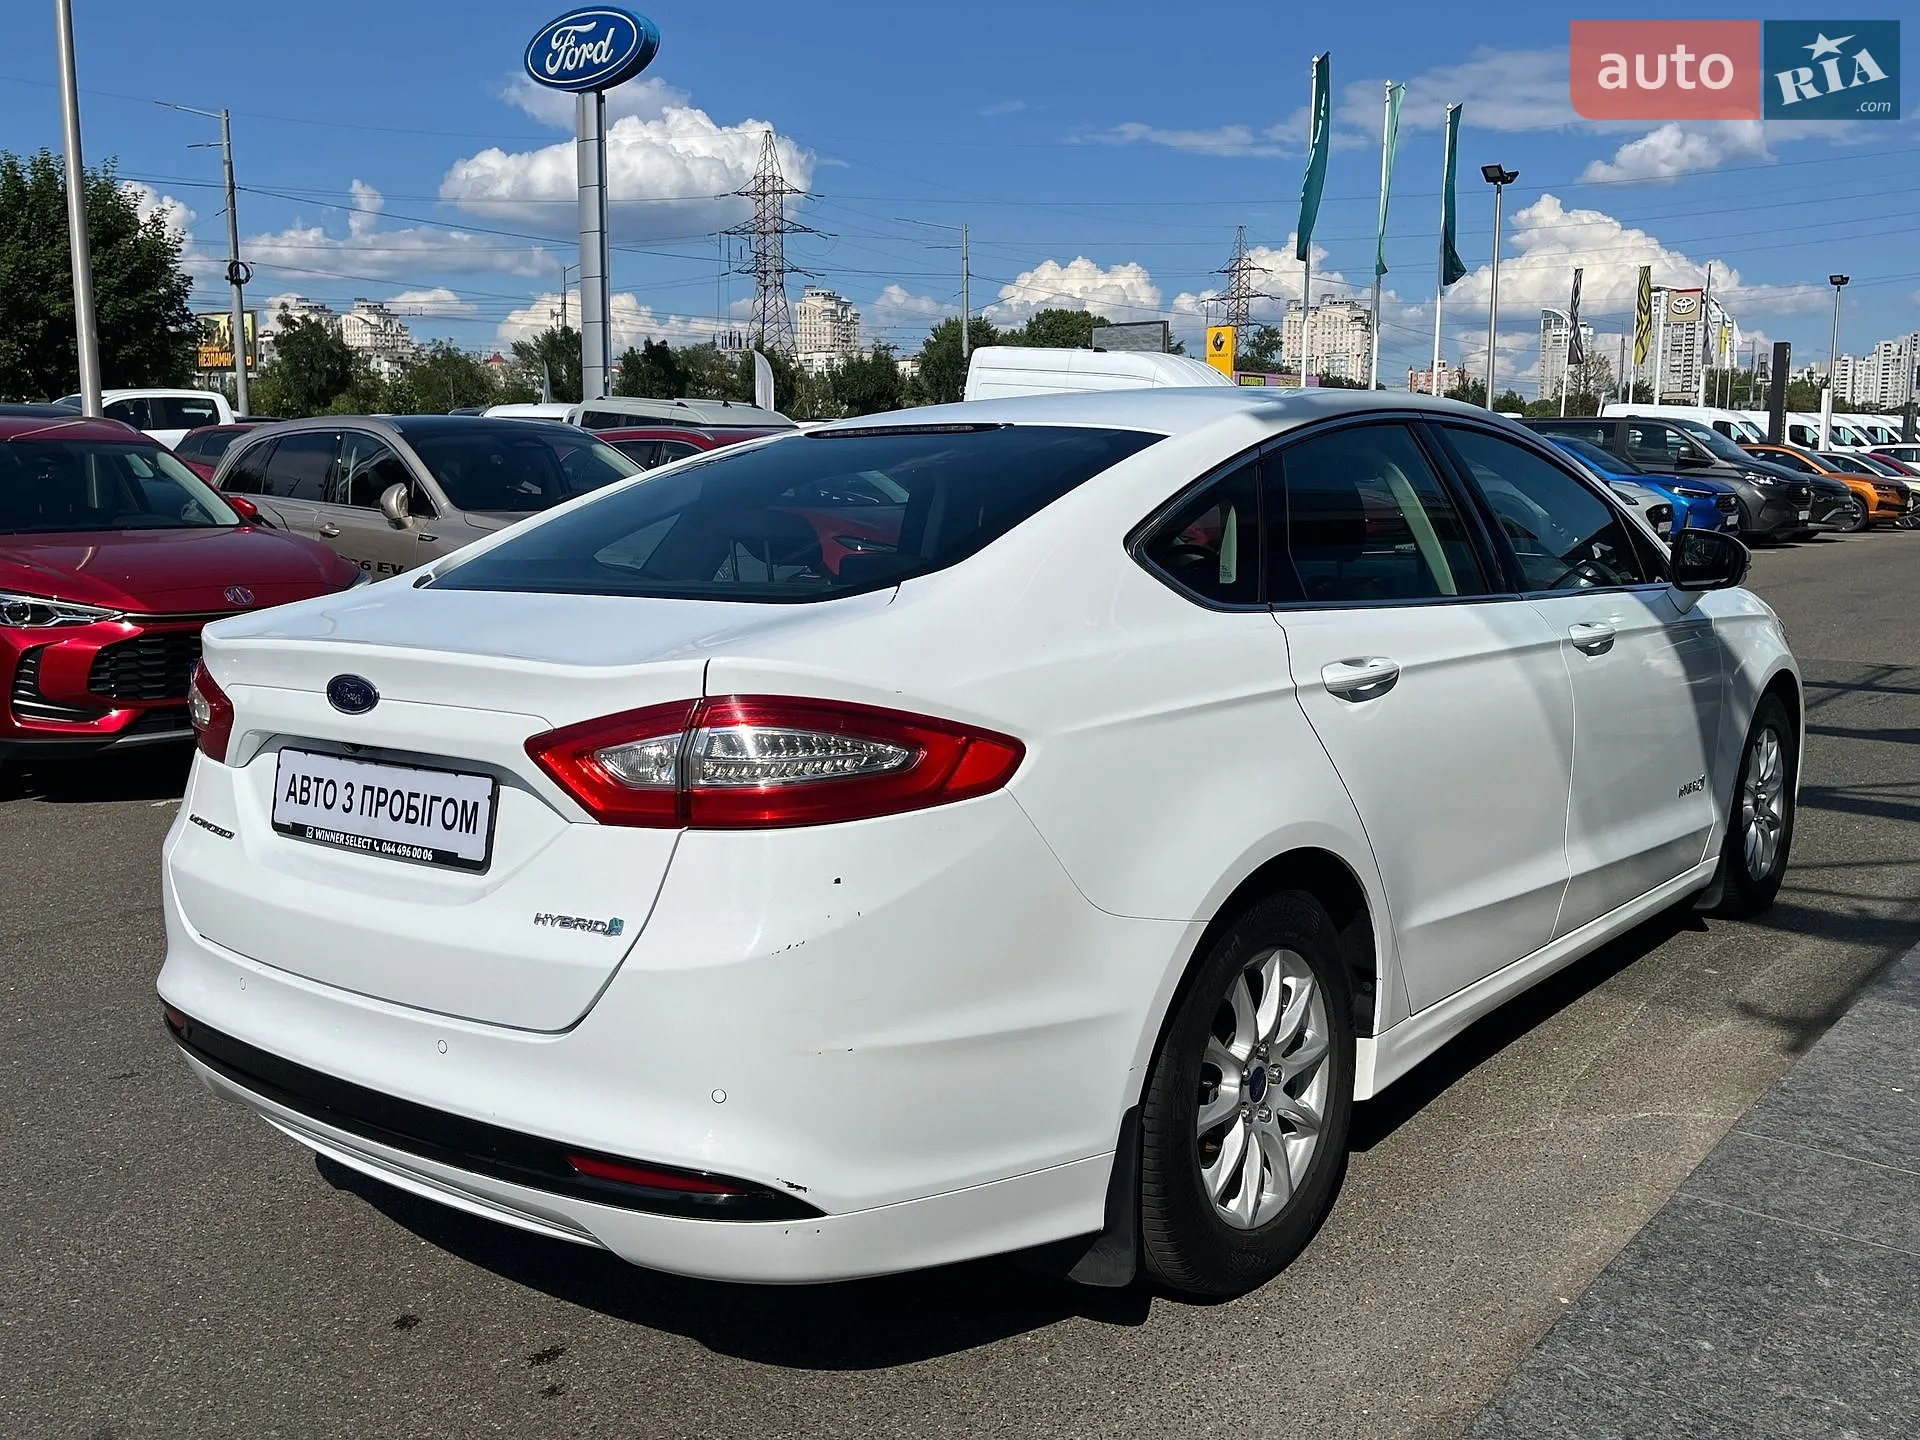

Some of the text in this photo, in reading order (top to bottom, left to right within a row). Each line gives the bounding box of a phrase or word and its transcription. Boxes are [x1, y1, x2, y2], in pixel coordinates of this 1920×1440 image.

[545, 21, 616, 75] Ford
[377, 561, 404, 575] EV
[225, 586, 255, 605] MG
[284, 773, 338, 811] АВТО
[359, 784, 480, 835] ПРОБІГОМ
[315, 828, 433, 861] WINNER SELECT 044 496 00 06
[533, 912, 608, 935] HYBRID
